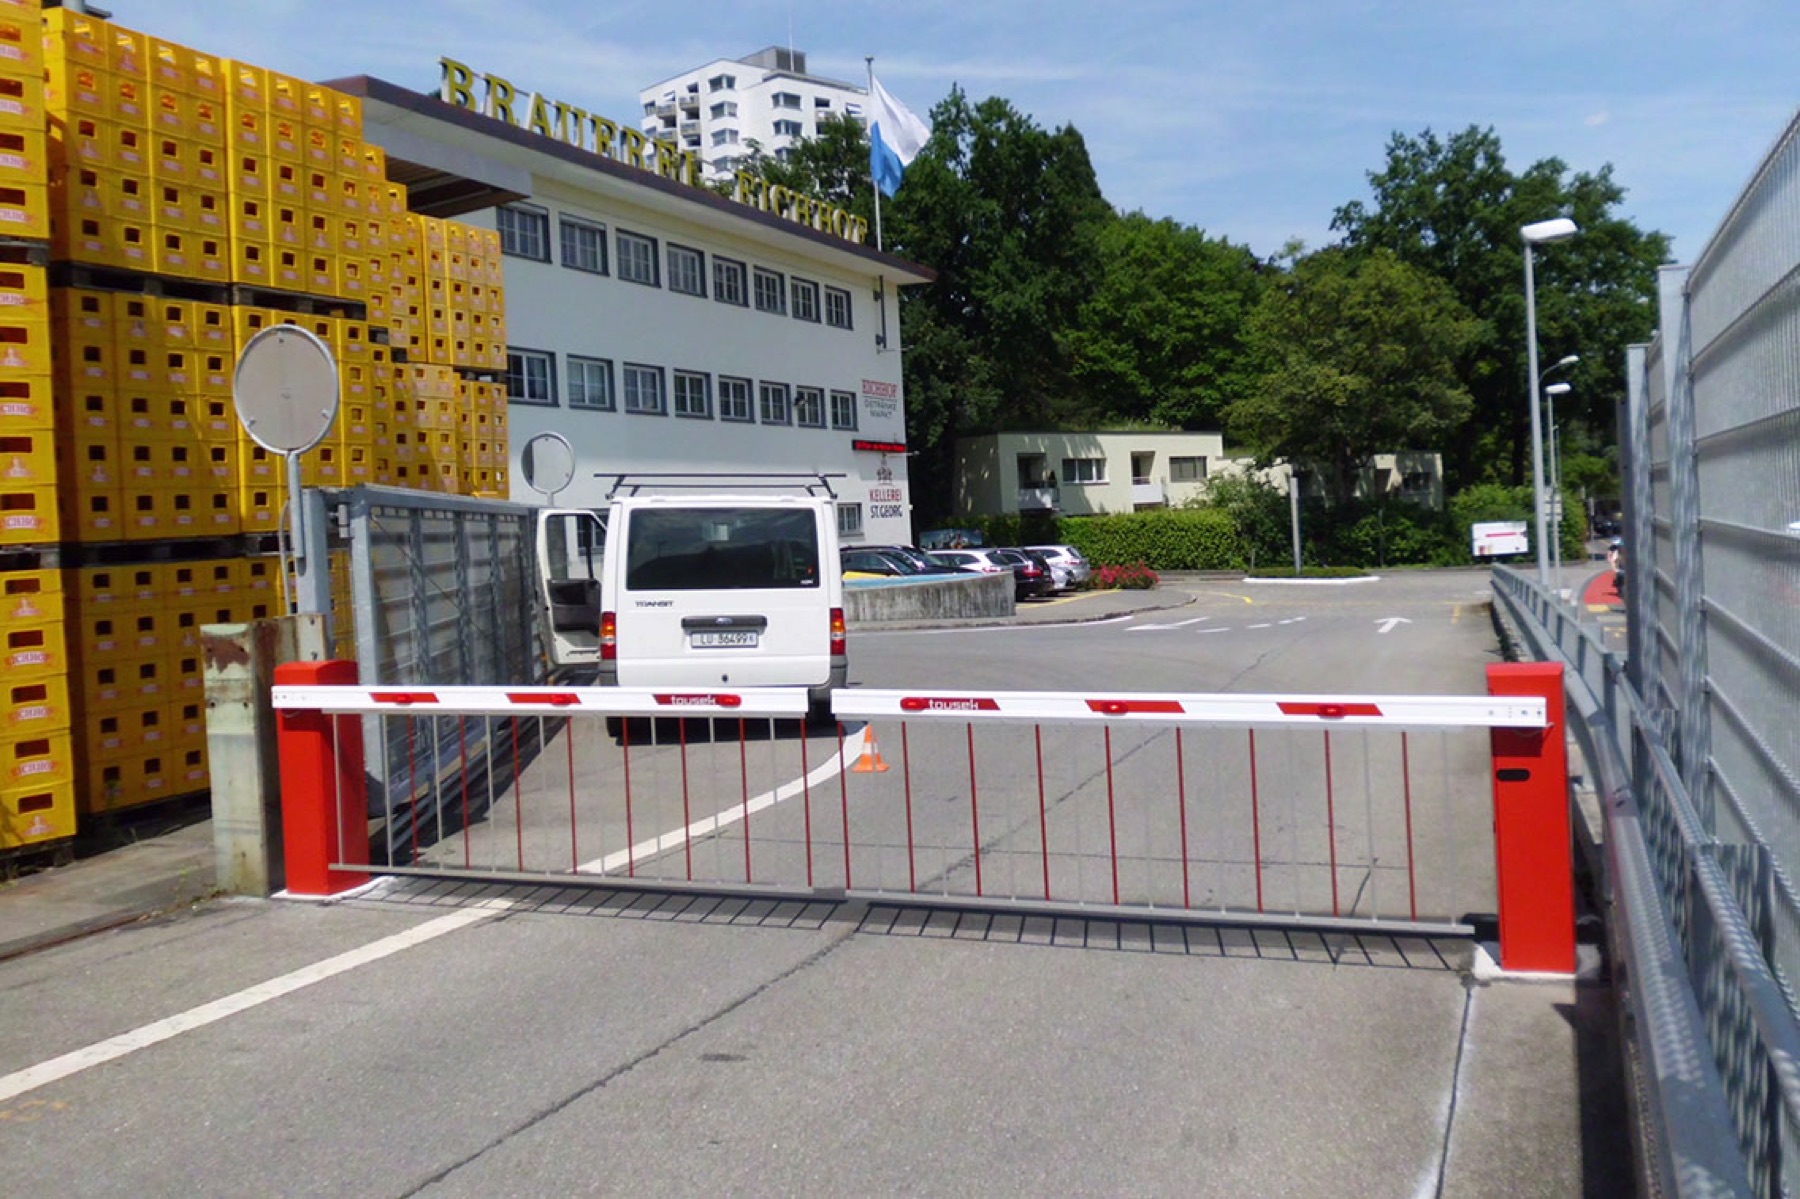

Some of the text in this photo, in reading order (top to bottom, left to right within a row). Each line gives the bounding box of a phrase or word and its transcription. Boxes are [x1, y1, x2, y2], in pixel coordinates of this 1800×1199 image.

[438, 56, 695, 186] BRAUEREI
[729, 169, 869, 245] EICHHOF
[671, 694, 716, 705] tousek
[928, 699, 979, 710] tousek
